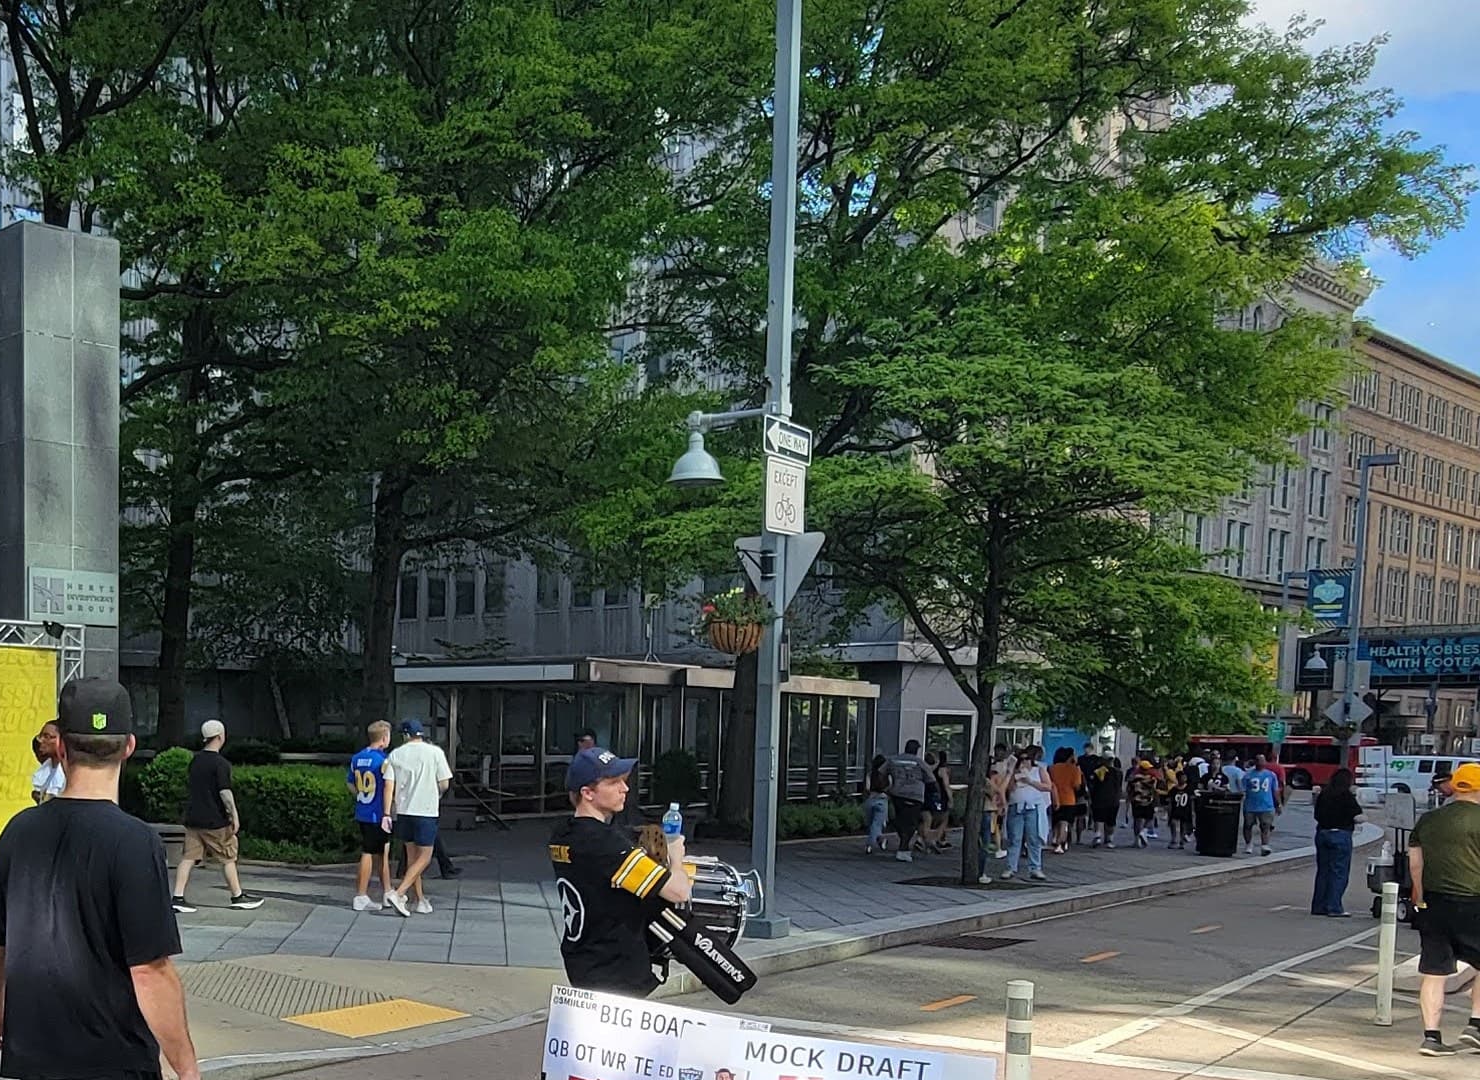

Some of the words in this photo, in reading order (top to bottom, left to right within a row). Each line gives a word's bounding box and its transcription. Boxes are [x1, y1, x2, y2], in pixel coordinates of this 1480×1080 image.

[779, 432, 791, 446] ONE
[794, 436, 807, 452] WAY
[774, 471, 798, 489] EXCEPT
[66, 604, 114, 613] GROUP
[1369, 645, 1430, 657] HEALTHY
[1385, 658, 1421, 669] WITH
[1250, 778, 1269, 792] 34
[600, 1004, 633, 1029] BIG
[548, 1037, 570, 1058] QB
[575, 1043, 597, 1064] OT
[601, 1048, 627, 1072] WR
[634, 1055, 655, 1077] TE
[744, 1040, 825, 1070] MOCK
